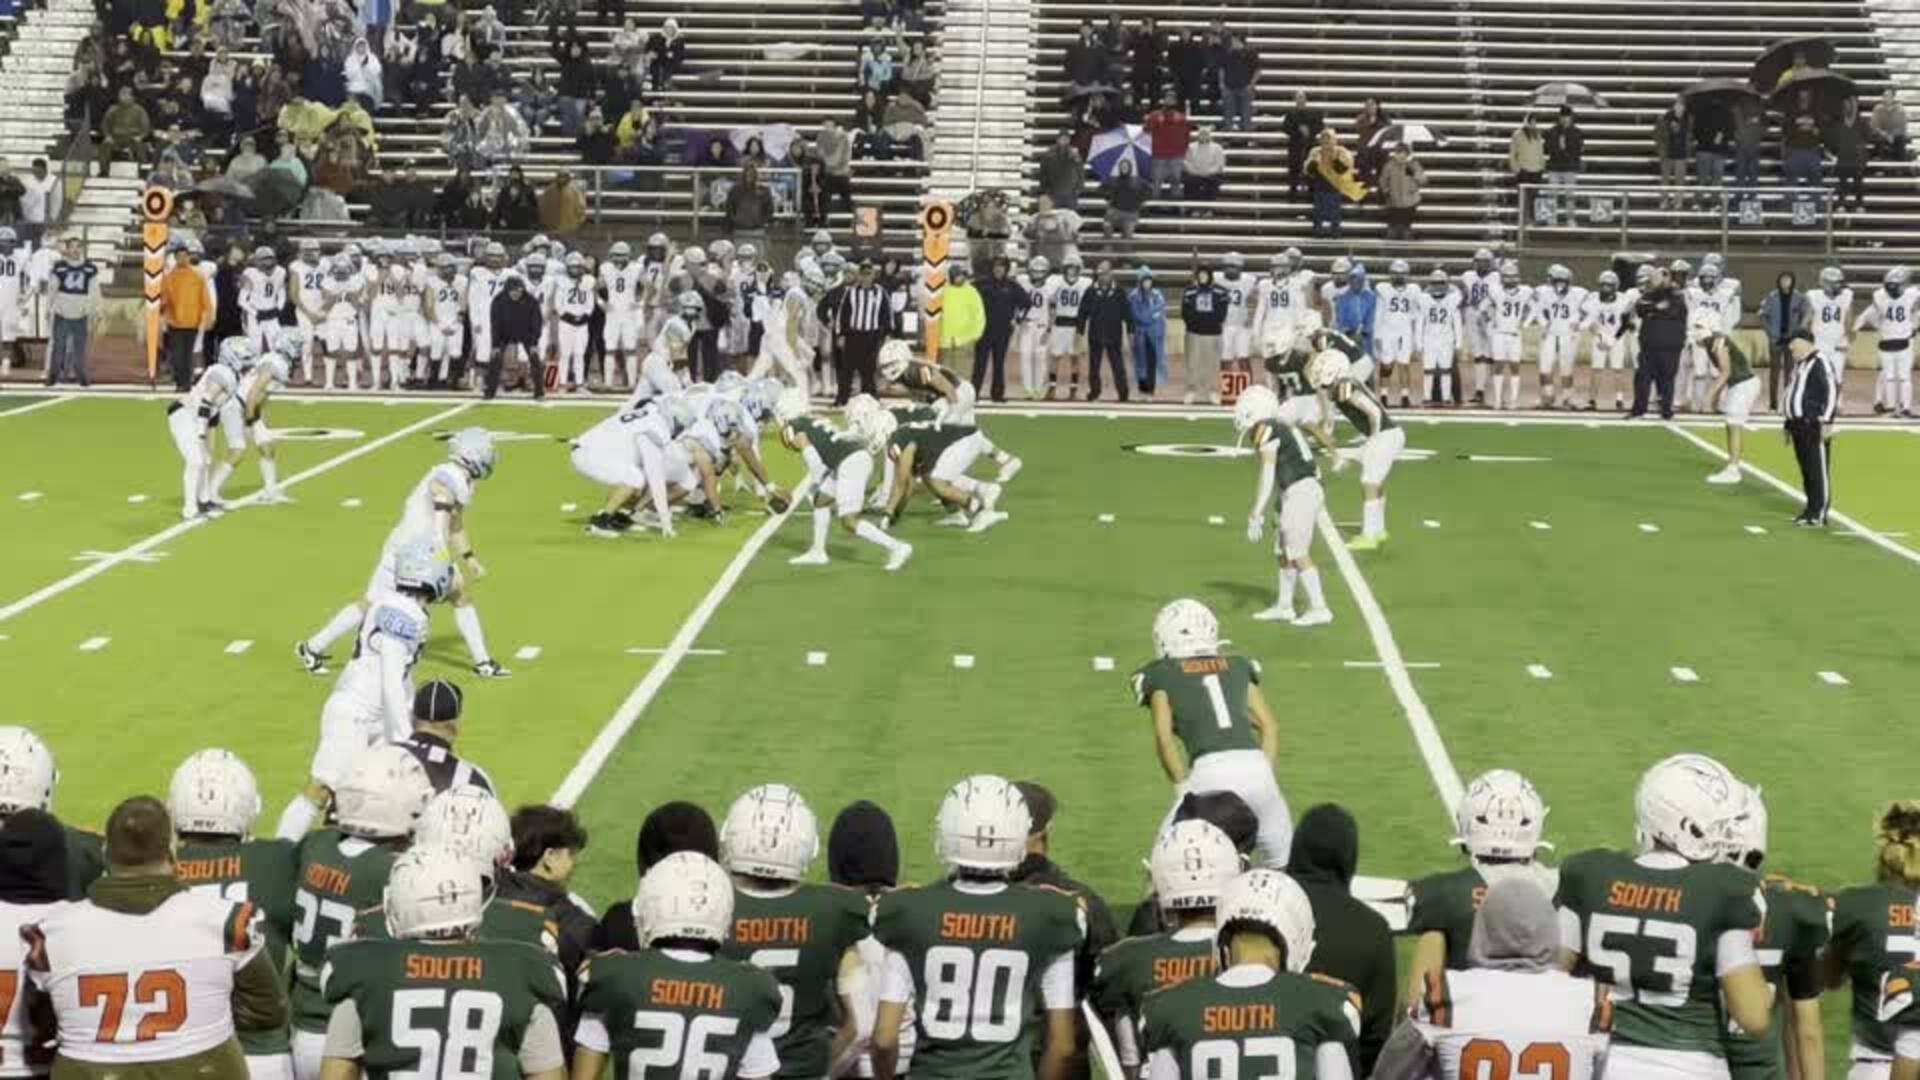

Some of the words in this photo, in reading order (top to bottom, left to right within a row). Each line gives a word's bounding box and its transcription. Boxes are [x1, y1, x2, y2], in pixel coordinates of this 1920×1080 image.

[1389, 296, 1410, 313] 53
[1502, 300, 1521, 317] 31
[1885, 305, 1906, 323] 48
[1221, 372, 1248, 396] 30
[1203, 672, 1232, 729] 1
[175, 855, 241, 880] SOUTH
[1609, 880, 1683, 913] SOUTH
[735, 917, 808, 943] SOUTH
[941, 911, 1017, 941] SOUTH
[405, 953, 483, 981] SOUTH
[1586, 911, 1698, 1008] 53
[78, 968, 188, 1043] 72
[651, 978, 724, 1009] SOUTH
[921, 945, 1030, 1042] 80
[387, 987, 503, 1080] 58
[1204, 1004, 1276, 1033] SOUTH
[628, 1011, 740, 1080] 26
